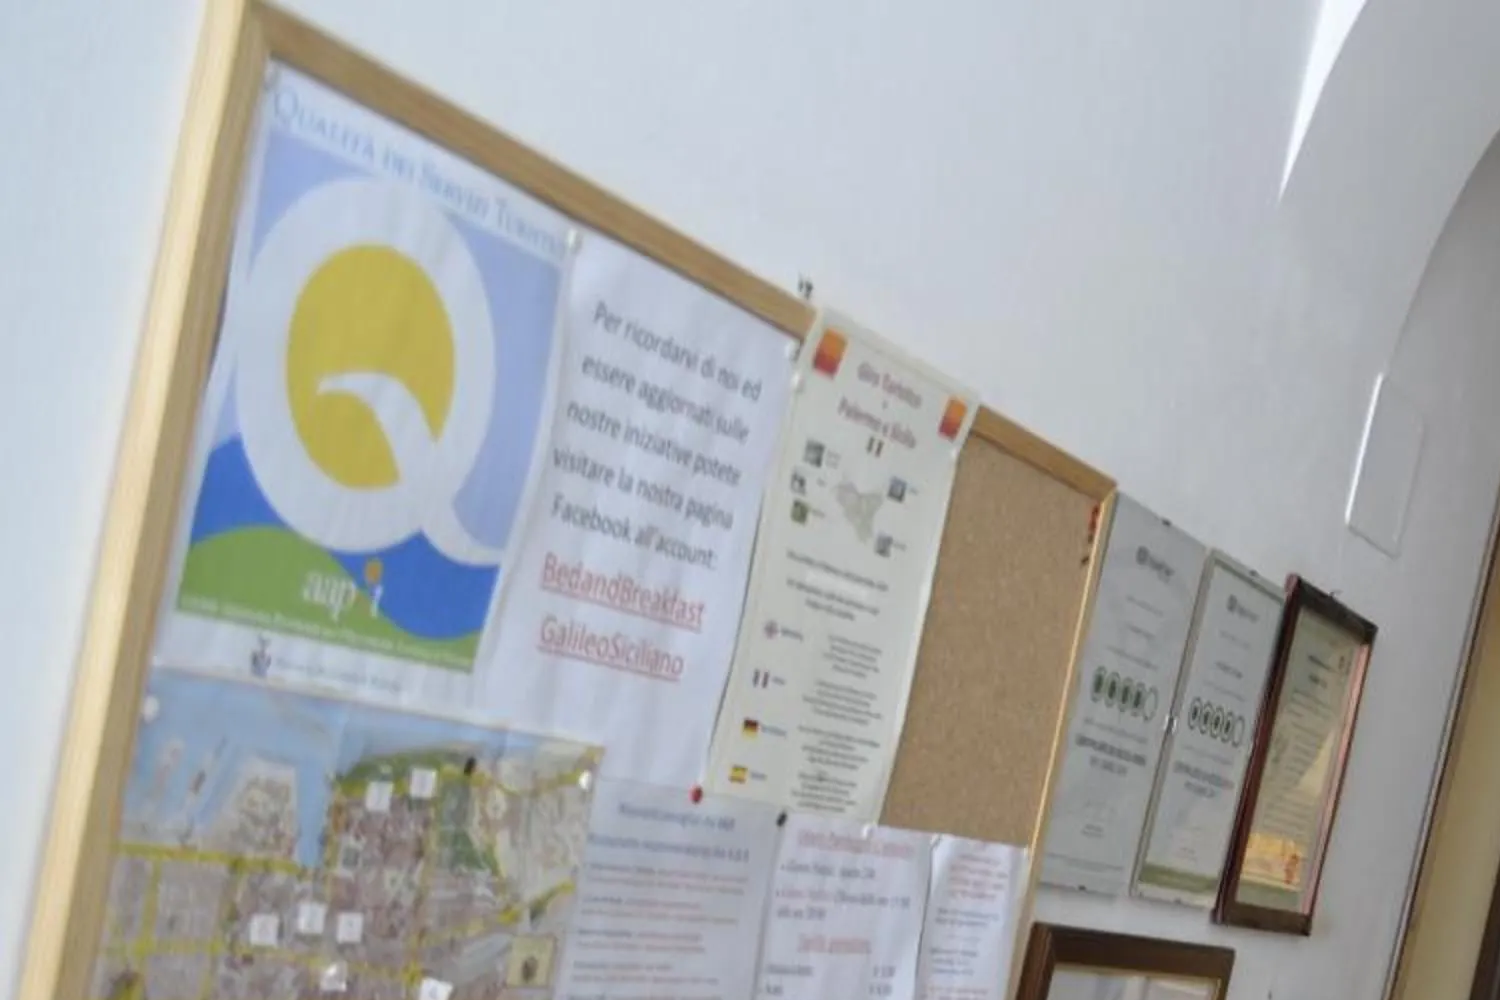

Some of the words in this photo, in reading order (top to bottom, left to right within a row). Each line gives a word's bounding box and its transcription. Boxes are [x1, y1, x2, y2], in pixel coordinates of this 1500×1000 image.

[593, 300, 623, 335] Per
[701, 353, 716, 380] di
[717, 365, 739, 391] noi
[741, 377, 764, 403] ed
[581, 354, 636, 394] essere
[715, 411, 751, 446] sulle
[566, 400, 622, 441] nostre
[622, 417, 693, 467] iniziative
[692, 452, 743, 488] potete
[551, 491, 632, 544] Facebook
[552, 445, 616, 488] visitare
[617, 466, 634, 493] la
[636, 477, 684, 514] nostra
[684, 496, 734, 532] pagina
[542, 550, 705, 632] BedandBreakfast
[538, 614, 684, 682] GalileoSiciliano
